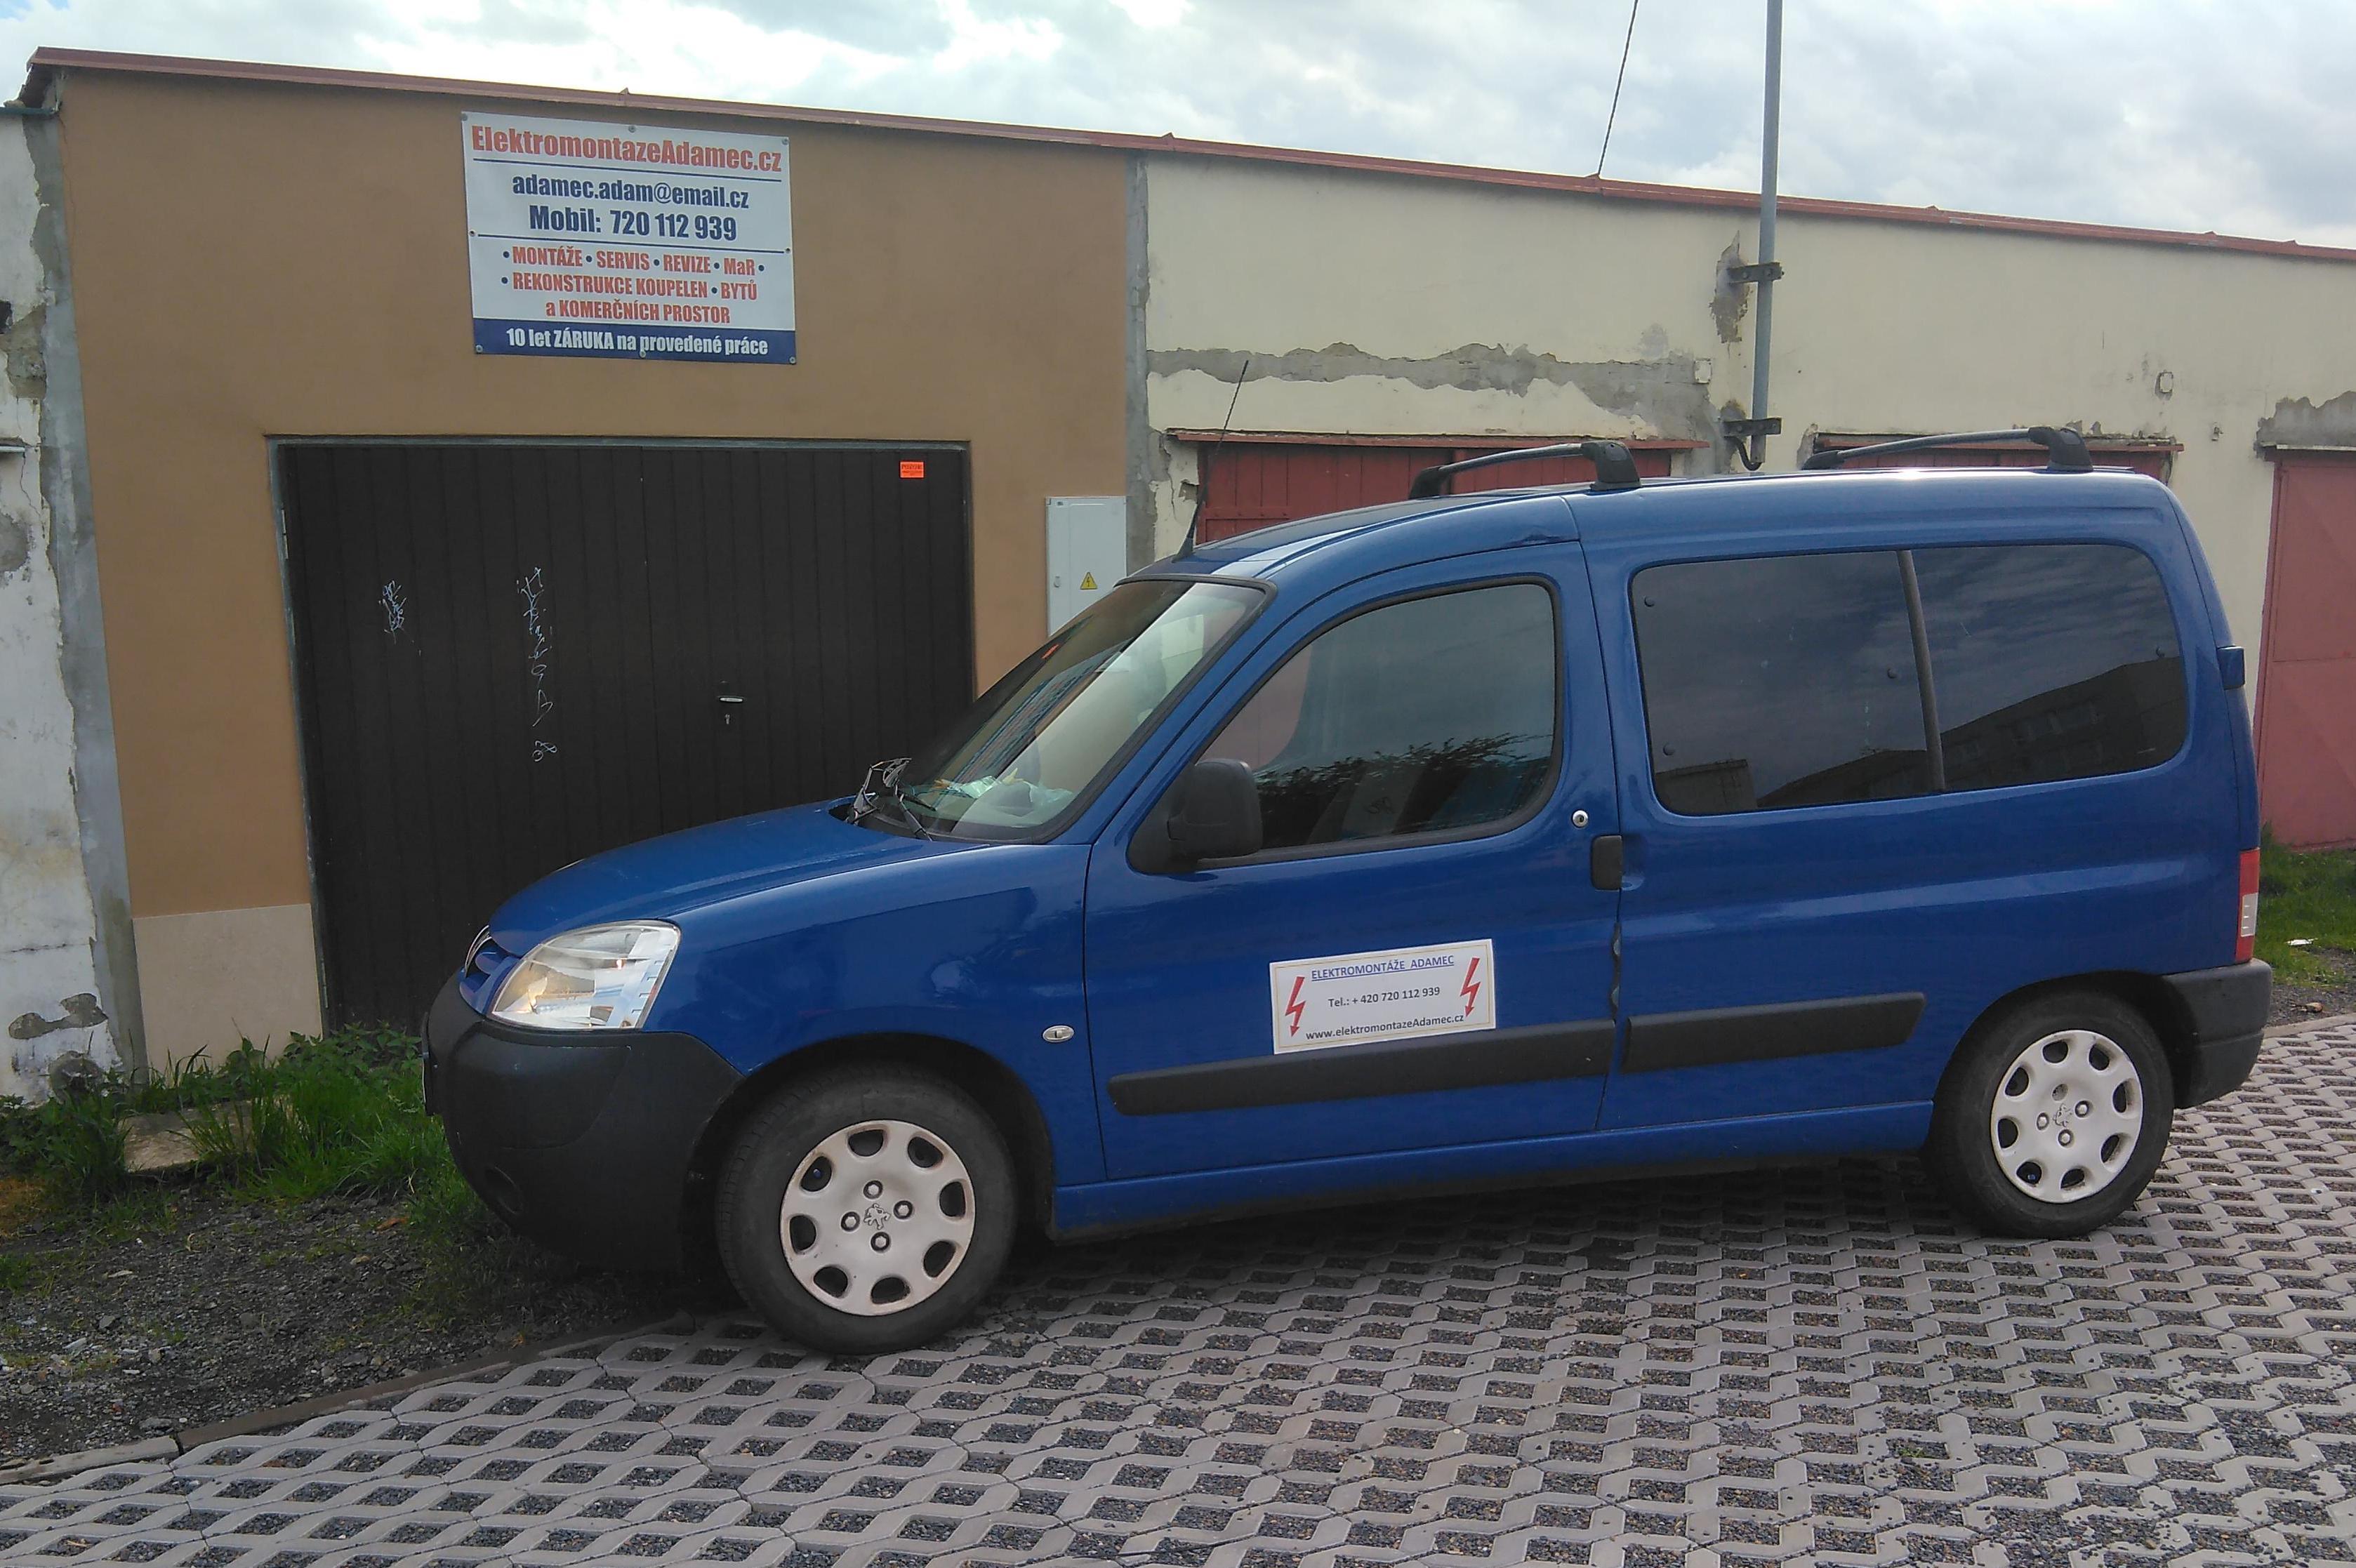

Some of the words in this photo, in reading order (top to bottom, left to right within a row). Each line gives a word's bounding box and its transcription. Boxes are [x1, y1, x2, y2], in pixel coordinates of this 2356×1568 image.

[472, 125, 782, 173] ElektromontazeAdamec.cz
[512, 173, 749, 209] adamec.adam@email.cz
[529, 205, 601, 234] Mobil:
[610, 210, 649, 237] 720
[654, 213, 689, 237] 112
[695, 215, 737, 241] 939
[512, 244, 583, 267] MONTÁŽE
[597, 251, 649, 271] SERVIS
[663, 255, 710, 273] REVIZE
[724, 258, 755, 276] MaR
[512, 272, 632, 295] REKONSTRUKCE
[636, 278, 708, 298] KOUPELEN
[721, 279, 757, 300] BYTŮ
[546, 301, 555, 316] a
[559, 298, 660, 321] KOMERČNÍCH
[663, 304, 730, 324] PROSTOR
[507, 328, 525, 347] 10
[529, 329, 551, 348] let
[553, 327, 614, 350] ZÁRUKA
[617, 335, 636, 352] na
[640, 333, 722, 356] provedené
[725, 336, 768, 356] práce
[1311, 959, 1405, 980] ELEKTROMONTÁŽE
[1410, 955, 1454, 969] ADAMEC
[1328, 997, 1349, 1008] Tel.:
[1361, 994, 1378, 1004] 420
[1382, 991, 1399, 1002] 720
[1403, 989, 1420, 999] 112
[1422, 986, 1440, 997] 939
[1306, 1014, 1464, 1040] www.elektromontazeAdamec.cz
